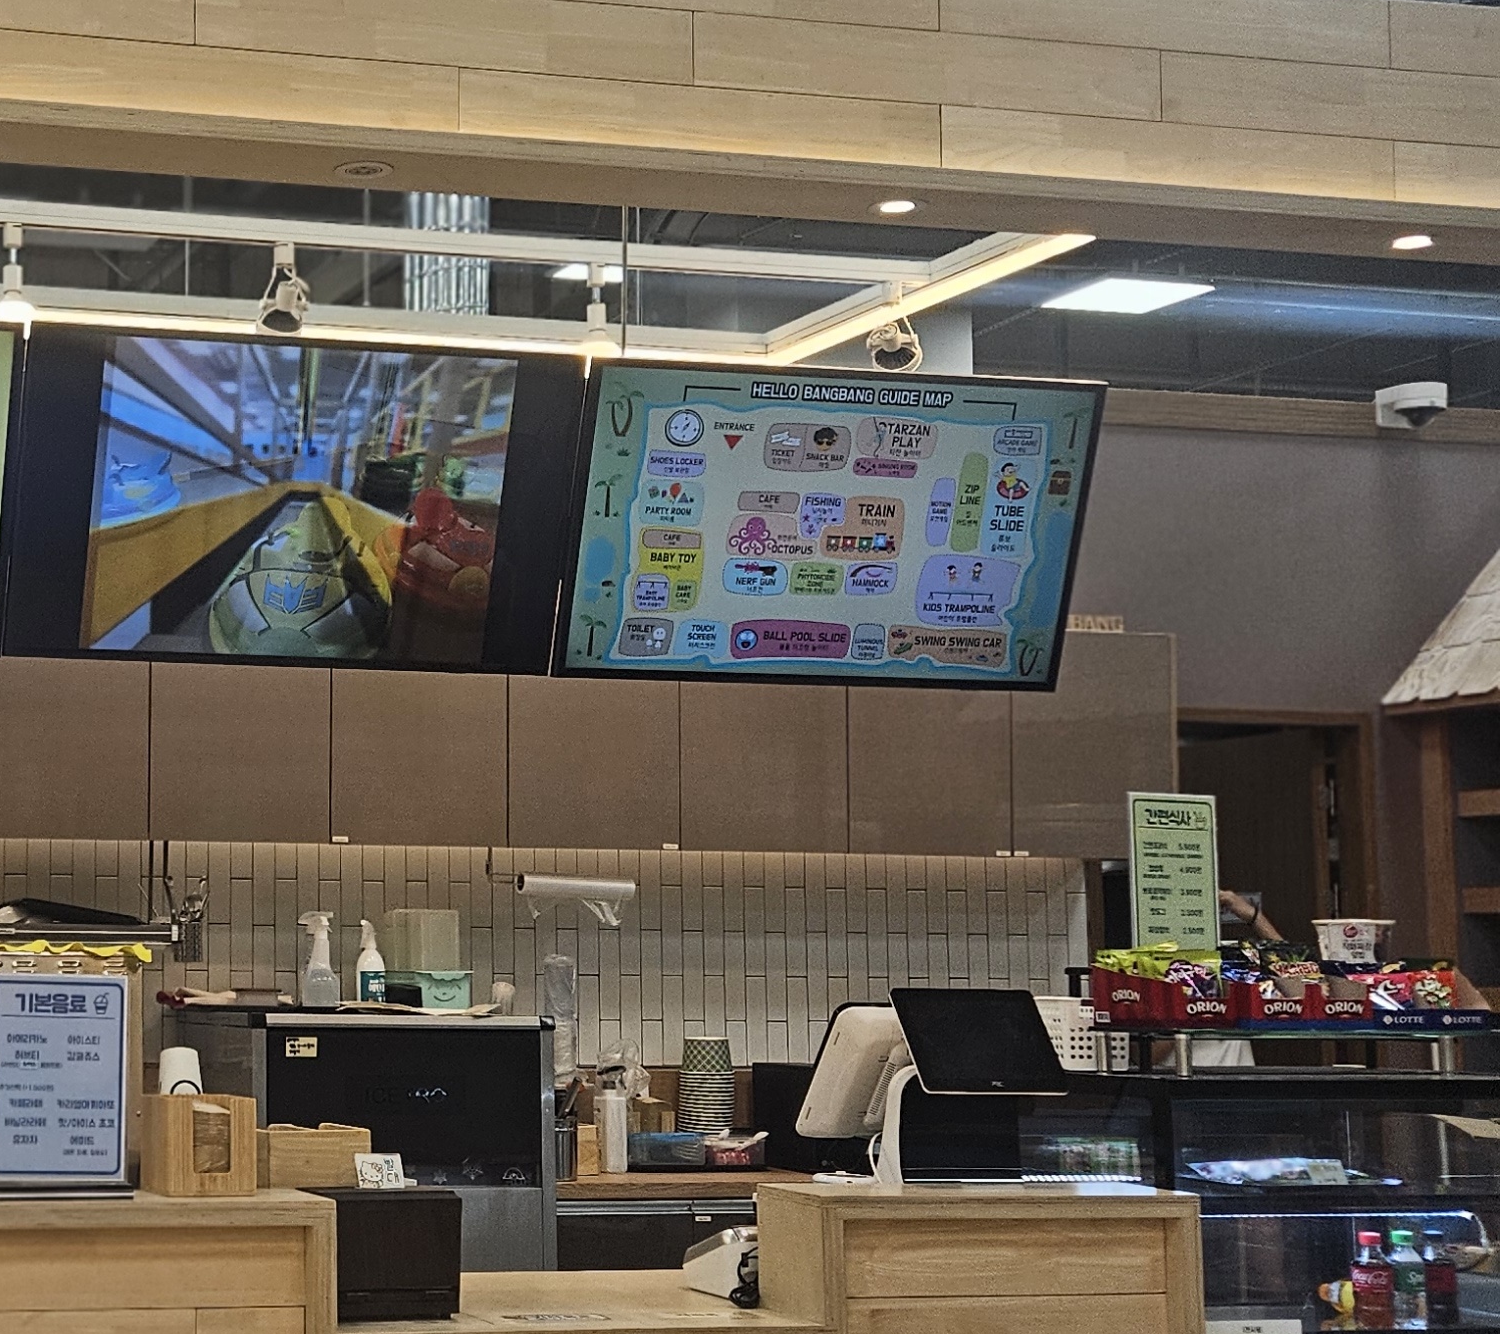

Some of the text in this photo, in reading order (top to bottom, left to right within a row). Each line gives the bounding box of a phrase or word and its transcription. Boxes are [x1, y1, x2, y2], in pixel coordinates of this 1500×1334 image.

[752, 383, 952, 407] HELLO BANGBANG GUIDE MAP
[714, 421, 755, 432] ENTRANCE
[888, 423, 930, 436] TARZAN
[891, 436, 922, 448] PLAY
[650, 456, 674, 465] SHOES
[828, 454, 844, 462] BAR
[964, 484, 980, 494] ZIP
[758, 494, 780, 504] CAFE
[805, 496, 841, 508] FISHING
[960, 496, 980, 505] LINE
[645, 506, 692, 516] PARTY ROOM
[859, 503, 895, 518] TRAIN
[995, 505, 1025, 518] TUBE
[990, 520, 1024, 532] SLIDE
[664, 533, 680, 542] CAFE
[650, 553, 697, 563] BABY TOY
[735, 577, 776, 586] NERF GUN
[852, 578, 889, 588] HAMMOCK
[923, 603, 995, 614] KIDS TRAMPOLINE
[627, 624, 654, 633] TOILET
[691, 624, 715, 633] TOUCH
[687, 632, 717, 641] SCREEN
[763, 631, 847, 643] BALL POOL SLIDE
[914, 636, 1002, 648] SWING SWING CAR
[1145, 808, 1191, 826] 간편식사
[1112, 989, 1140, 1002] ORION
[15, 992, 87, 1014] 기본음료
[1186, 1001, 1364, 1015] ORION ORION ORION
[1394, 1015, 1483, 1024] LOTTE LOTTE
[7, 1033, 100, 1045] 아메리카노 아이스티
